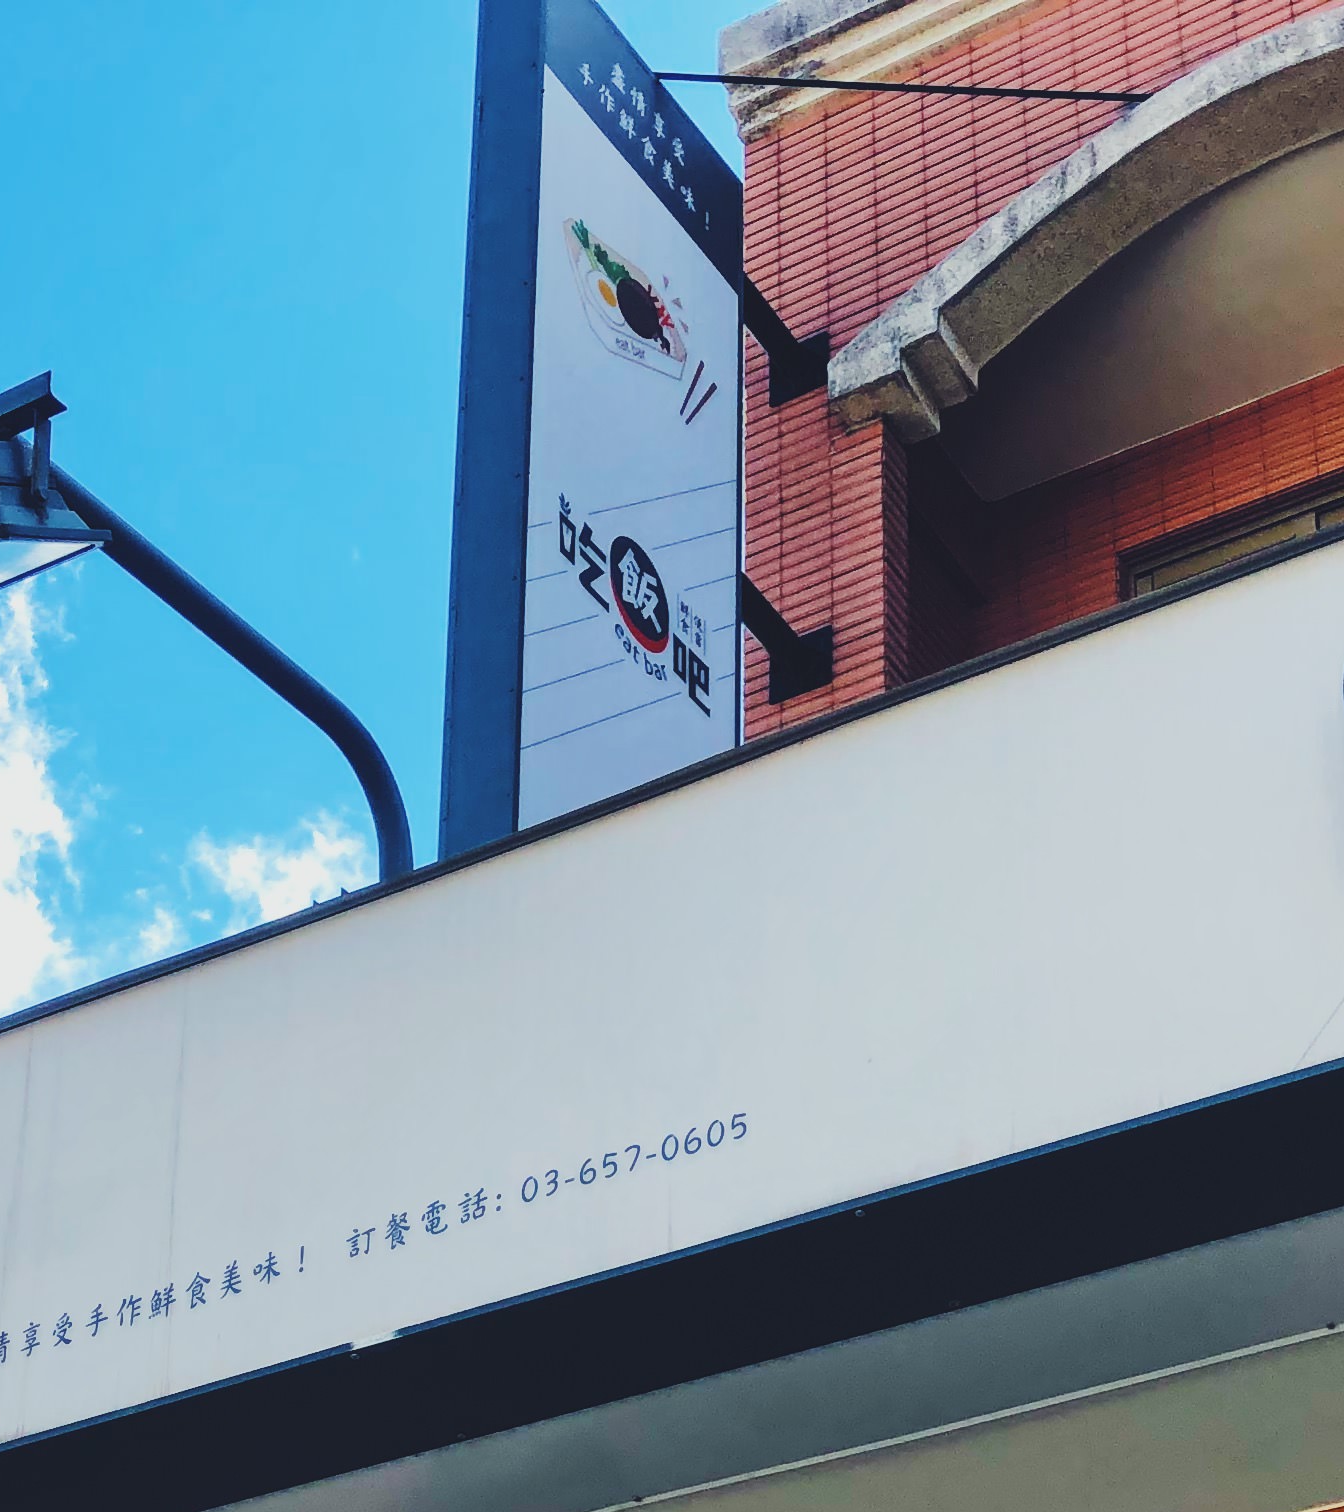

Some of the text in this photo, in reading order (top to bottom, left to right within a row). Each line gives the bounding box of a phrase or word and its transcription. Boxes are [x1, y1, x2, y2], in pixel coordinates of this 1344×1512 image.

[614, 622, 639, 664] eat
[644, 652, 669, 682] bar
[521, 1112, 748, 1203] 03-657-0605
